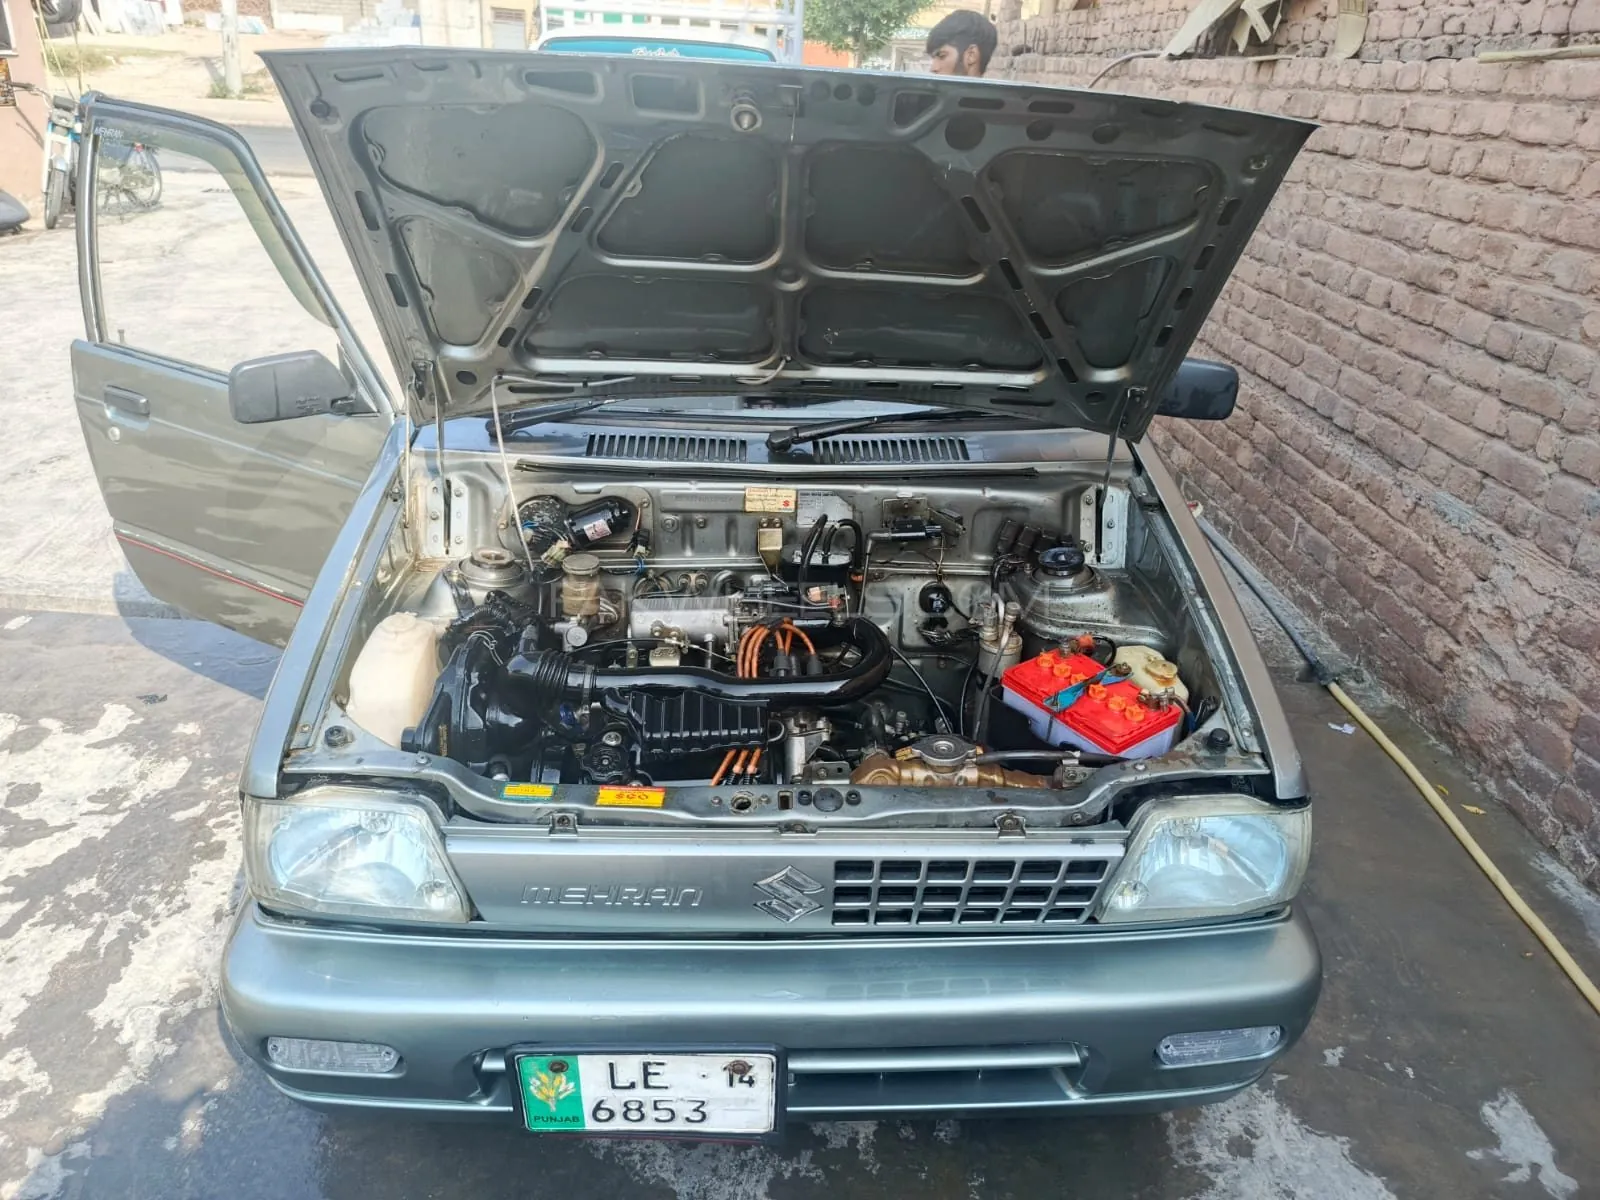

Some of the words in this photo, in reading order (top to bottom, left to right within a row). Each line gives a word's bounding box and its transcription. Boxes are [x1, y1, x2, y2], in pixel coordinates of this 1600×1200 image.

[521, 883, 703, 906] MEHRAN
[607, 1061, 669, 1090] LE
[534, 1115, 580, 1123] PUNJAB
[591, 1099, 708, 1123] 6853
